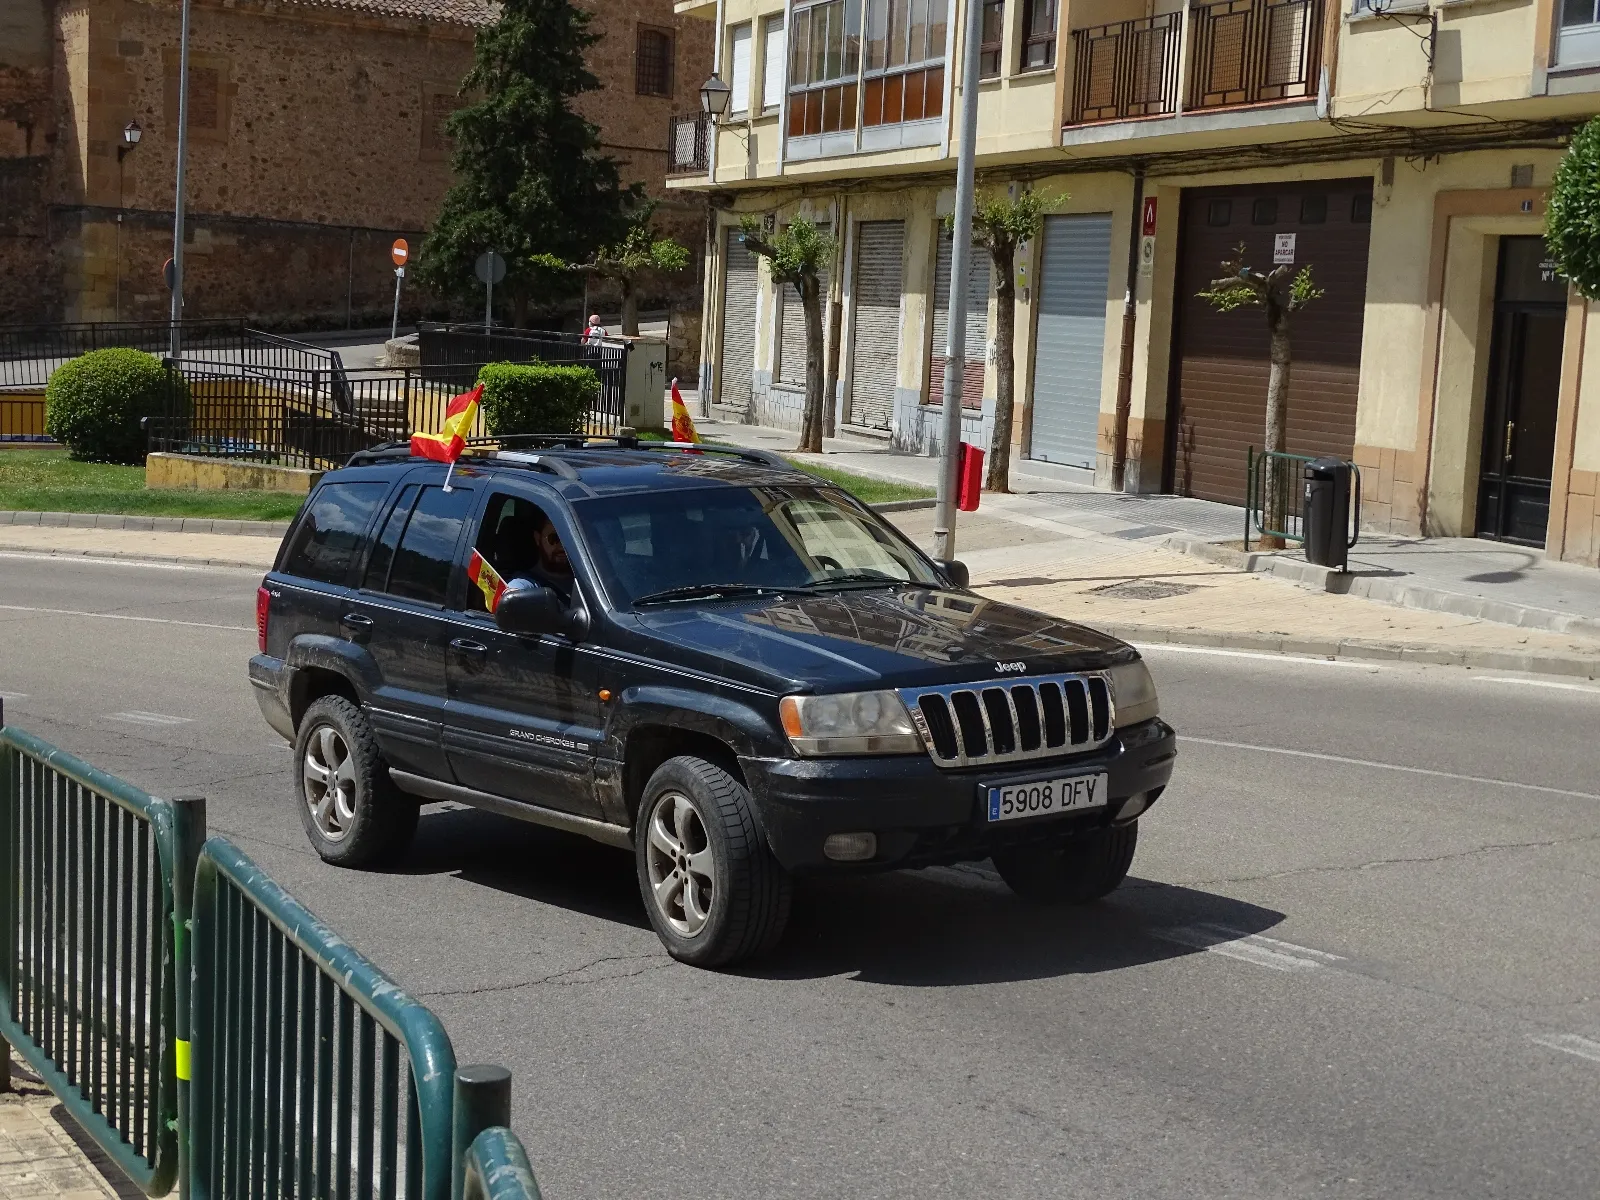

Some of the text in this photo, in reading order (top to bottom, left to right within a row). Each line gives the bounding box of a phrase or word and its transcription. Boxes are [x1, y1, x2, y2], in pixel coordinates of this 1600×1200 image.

[1281, 240, 1289, 248] NO
[1275, 248, 1294, 256] APARCAR
[994, 661, 1027, 673] Jeep
[509, 729, 535, 740] GRAND
[535, 734, 575, 748] CHEROKEE
[1001, 778, 1097, 815] 5908 DFV
